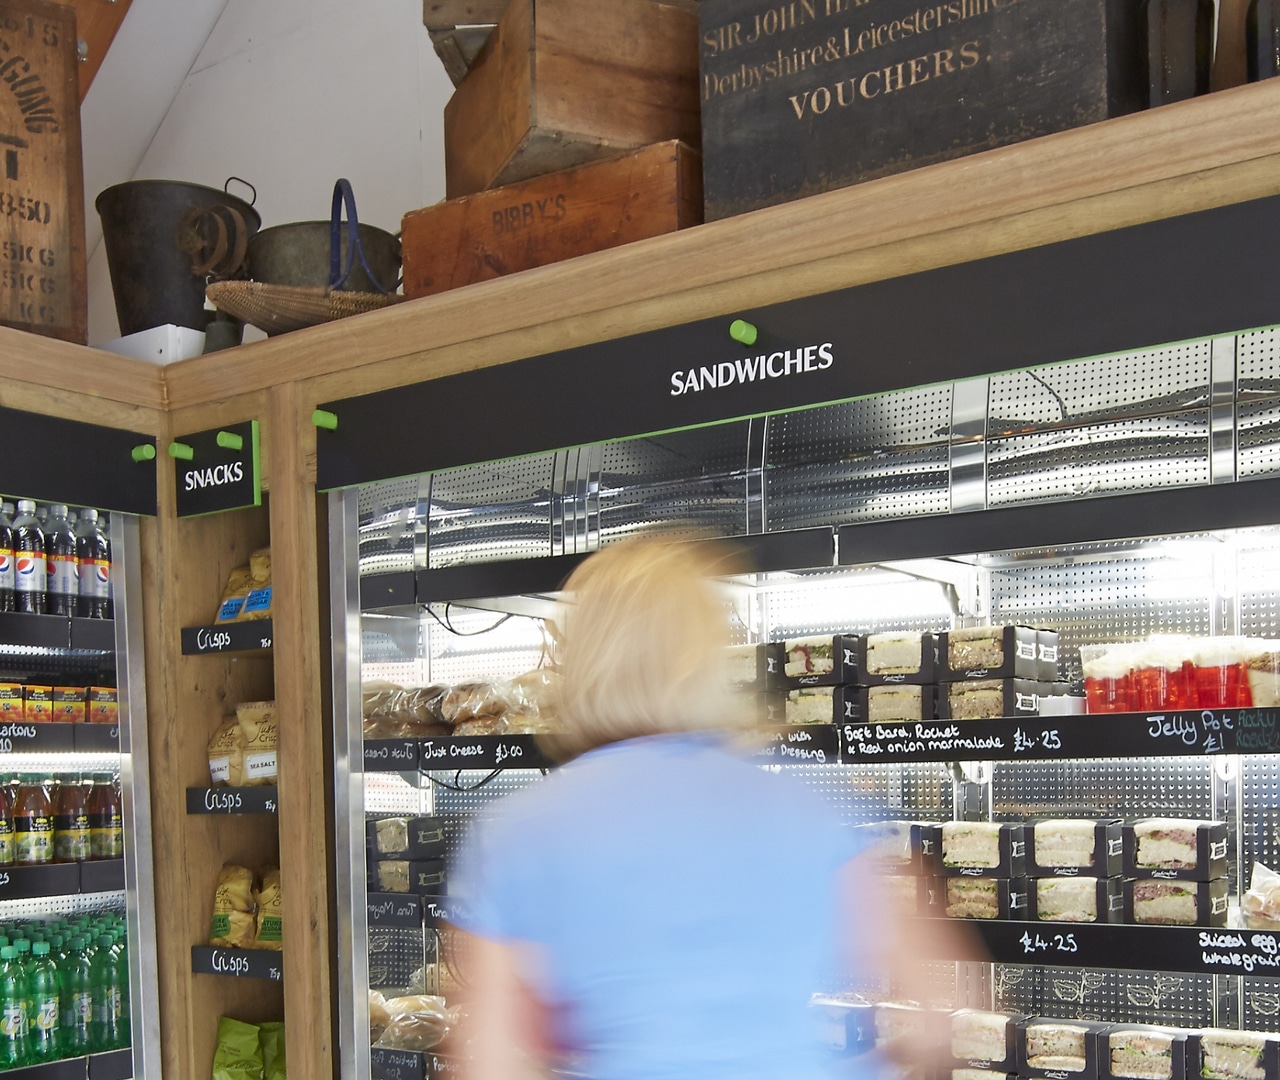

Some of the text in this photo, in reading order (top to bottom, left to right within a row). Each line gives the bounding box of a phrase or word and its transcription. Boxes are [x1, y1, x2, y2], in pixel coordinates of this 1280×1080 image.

[702, 22, 742, 57] SIR
[669, 342, 835, 397] SANDWICHES
[184, 461, 244, 492] SNACKS
[196, 628, 232, 650] Crisps
[1146, 709, 1234, 746] Jelly Pot
[424, 740, 448, 760] Just
[449, 744, 485, 757] Cheese
[780, 744, 827, 764] Dressing
[859, 743, 884, 756] Red
[887, 741, 926, 753] onion
[928, 735, 1005, 751] marmalade
[204, 788, 242, 814] Crisps
[427, 903, 448, 919] Tuna
[1018, 930, 1079, 954] £4.25
[211, 950, 250, 977] Crisps
